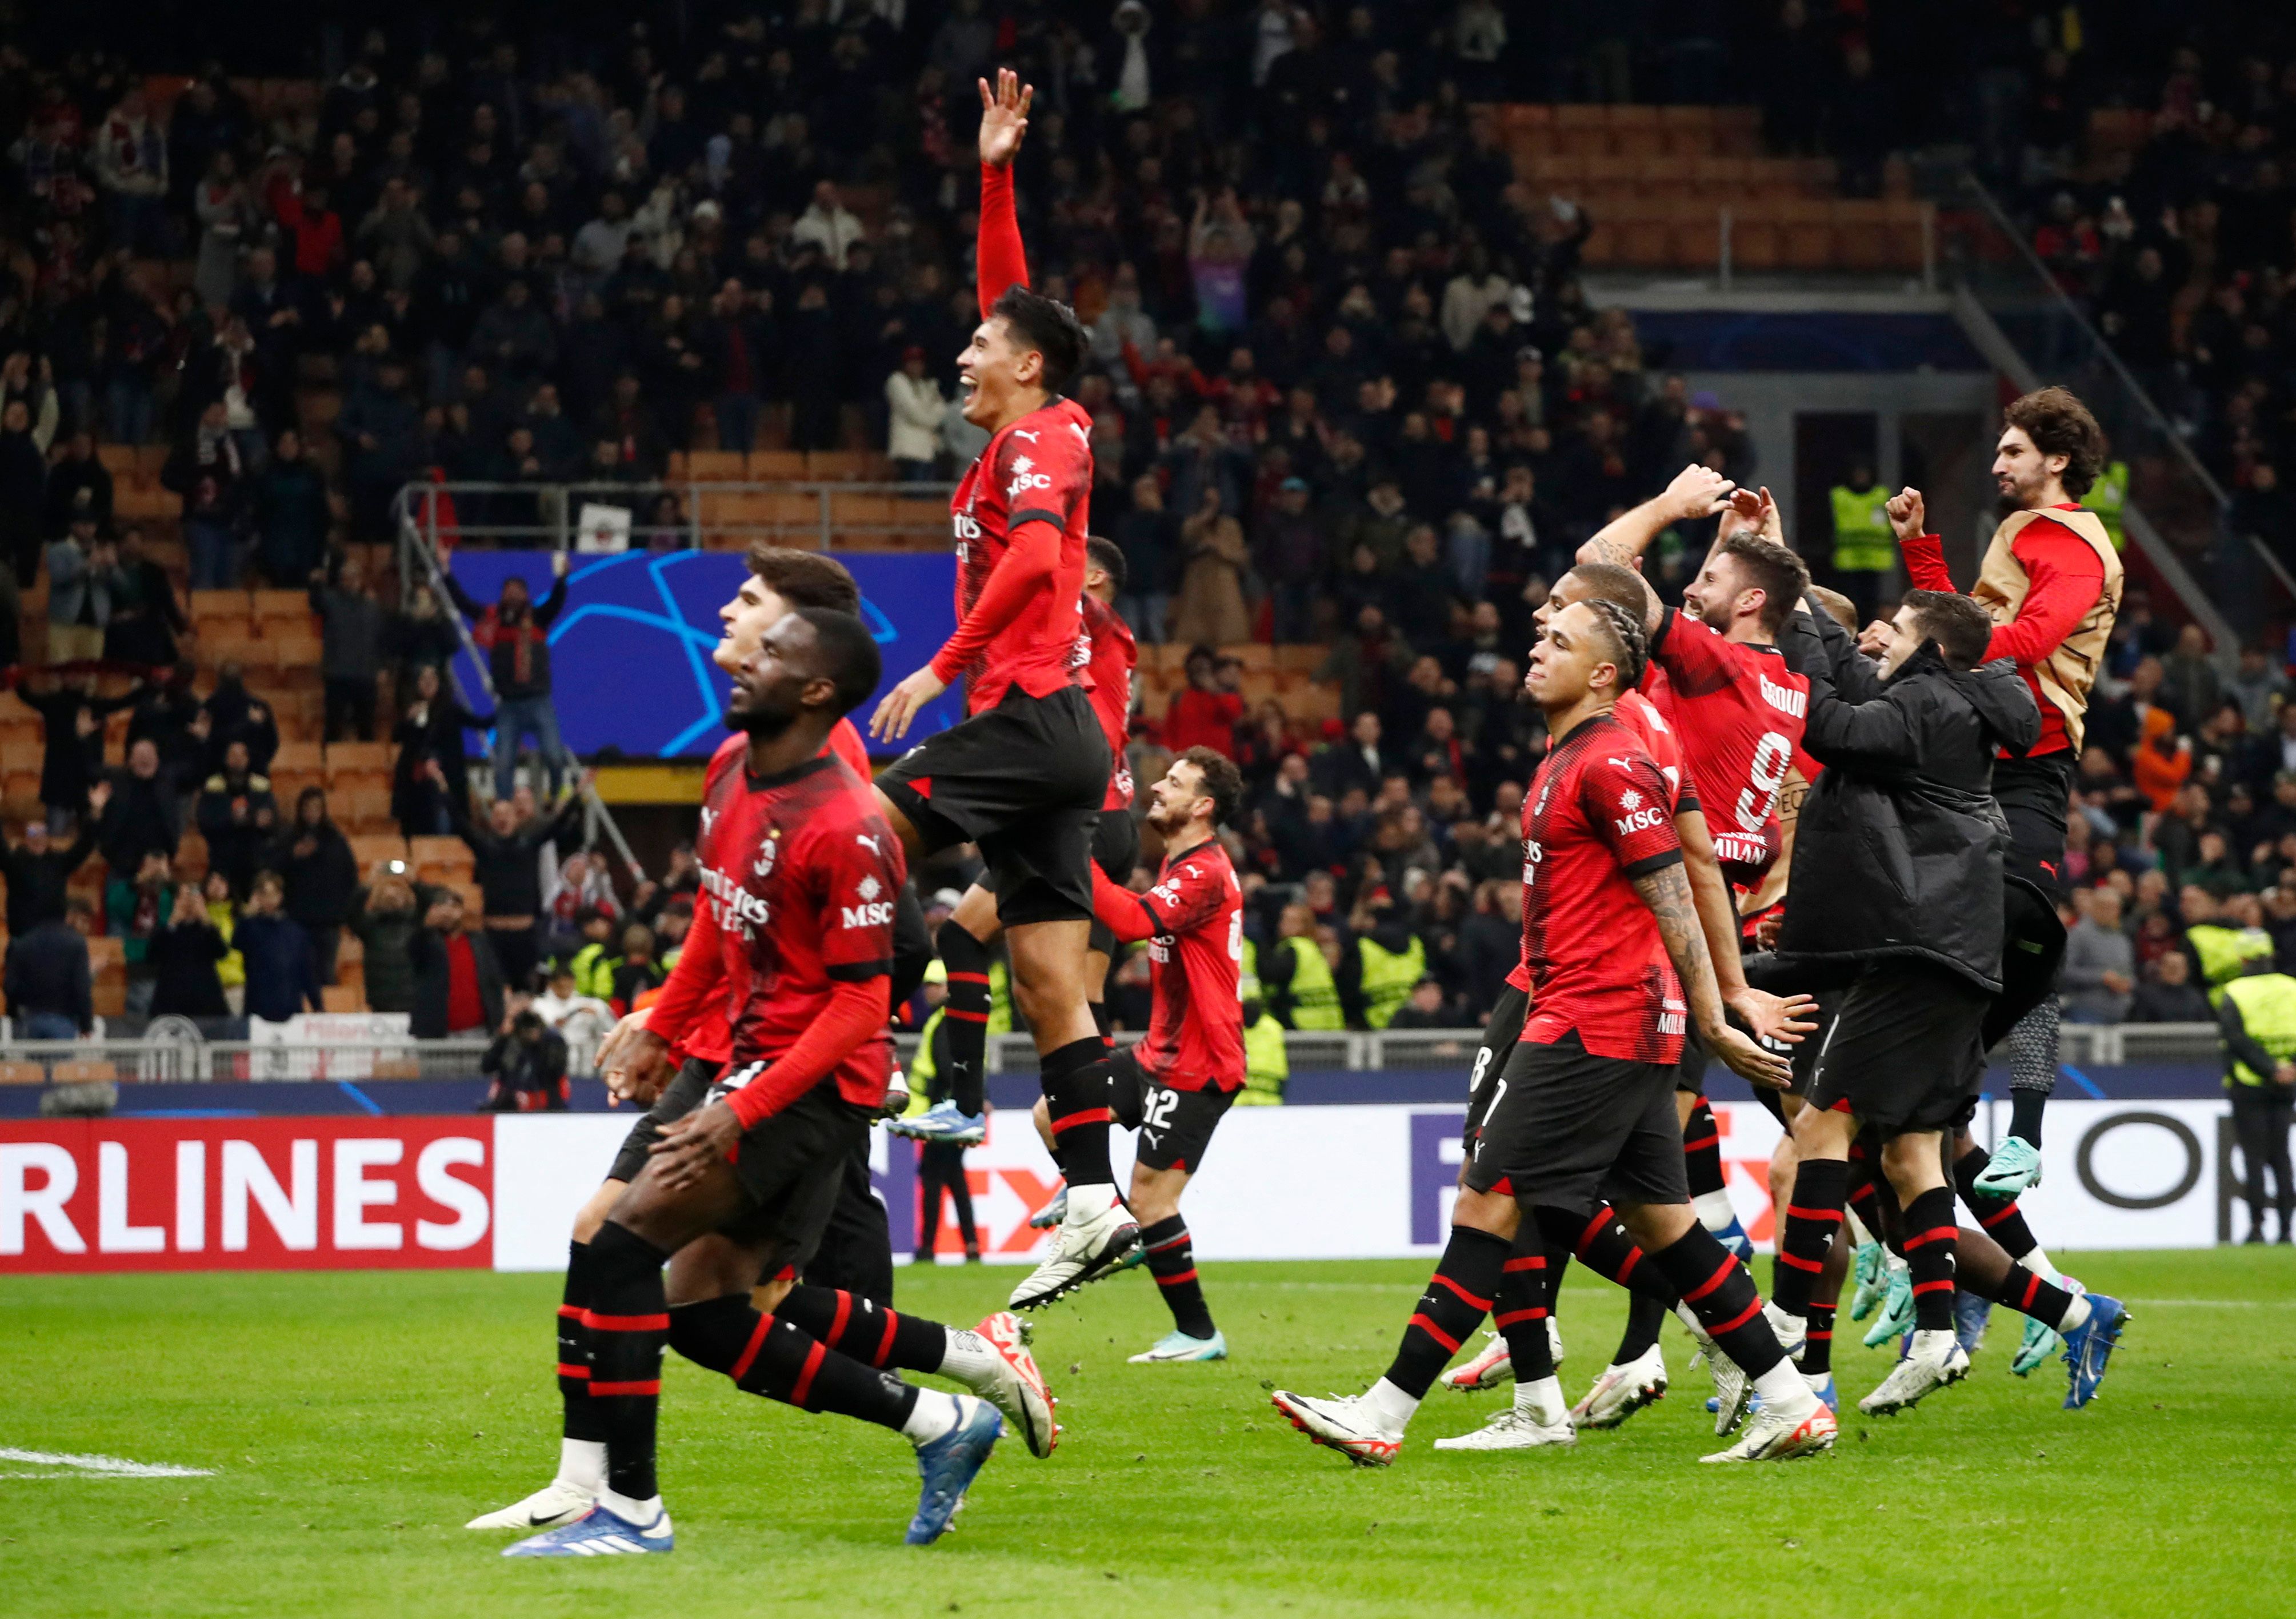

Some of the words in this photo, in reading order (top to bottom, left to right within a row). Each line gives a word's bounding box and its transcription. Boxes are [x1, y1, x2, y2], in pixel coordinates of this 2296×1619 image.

[1735, 731, 1792, 833] 9
[1614, 807, 1663, 836] MSC
[1714, 838, 1767, 866] MILAN
[841, 901, 894, 930] MSC
[1469, 1046, 1493, 1093] 8
[1143, 1086, 1179, 1130] 42
[1481, 1077, 1508, 1127] 7
